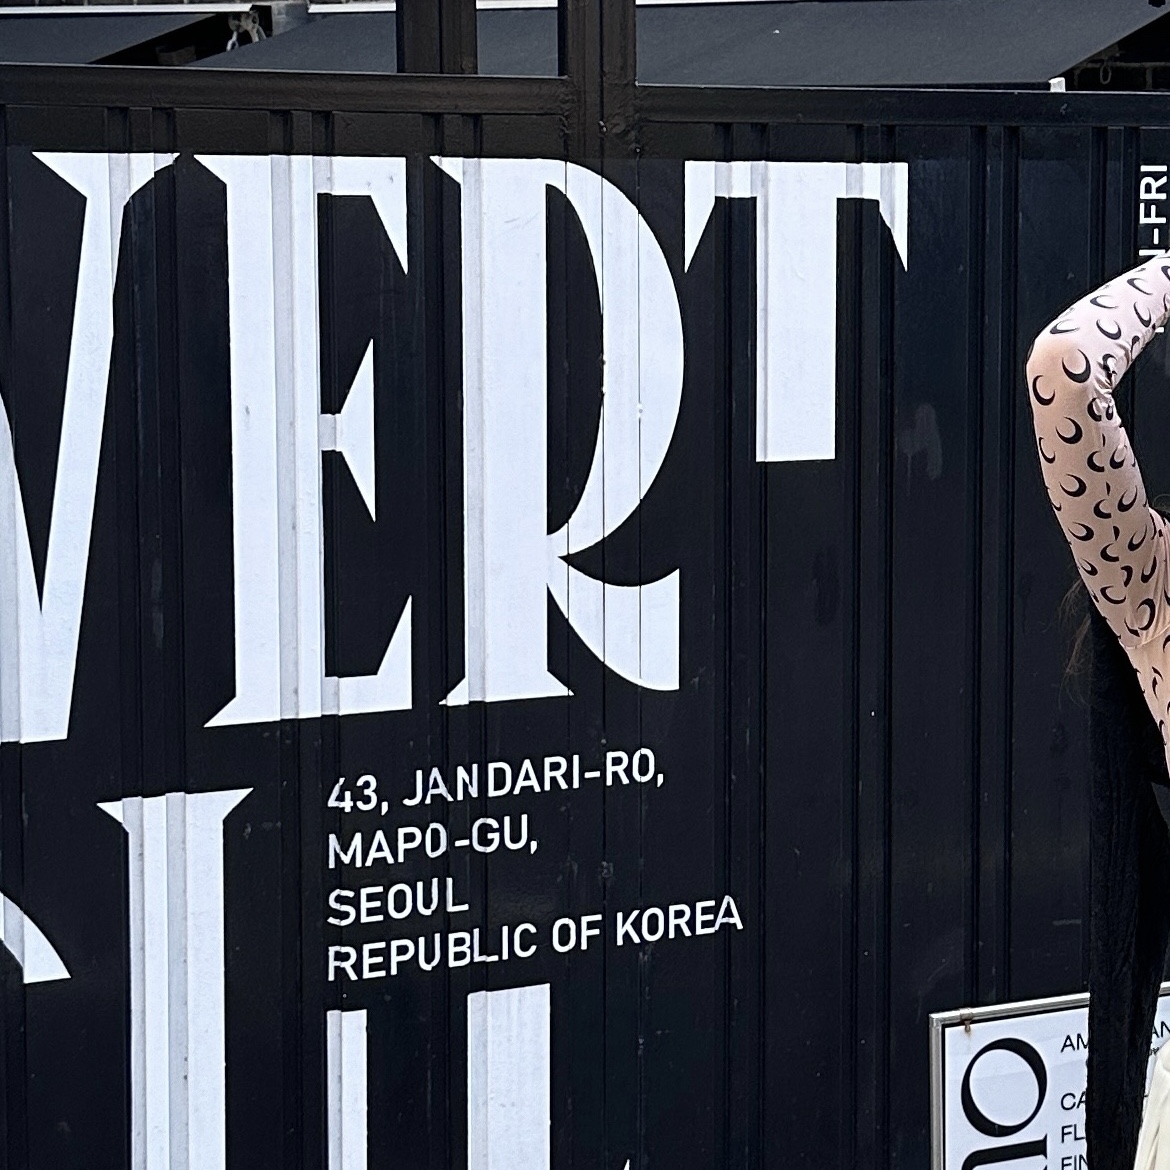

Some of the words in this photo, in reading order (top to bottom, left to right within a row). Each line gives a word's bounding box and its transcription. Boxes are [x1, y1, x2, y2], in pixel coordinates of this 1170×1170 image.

[327, 777, 389, 816] 43,
[402, 747, 664, 808] JANDARI-RO,
[328, 813, 538, 870] MAPO-GU,
[326, 877, 470, 927] SEOUL
[327, 922, 537, 982] REPUBLIC
[552, 913, 603, 953] OF
[616, 894, 744, 946] KOREA
